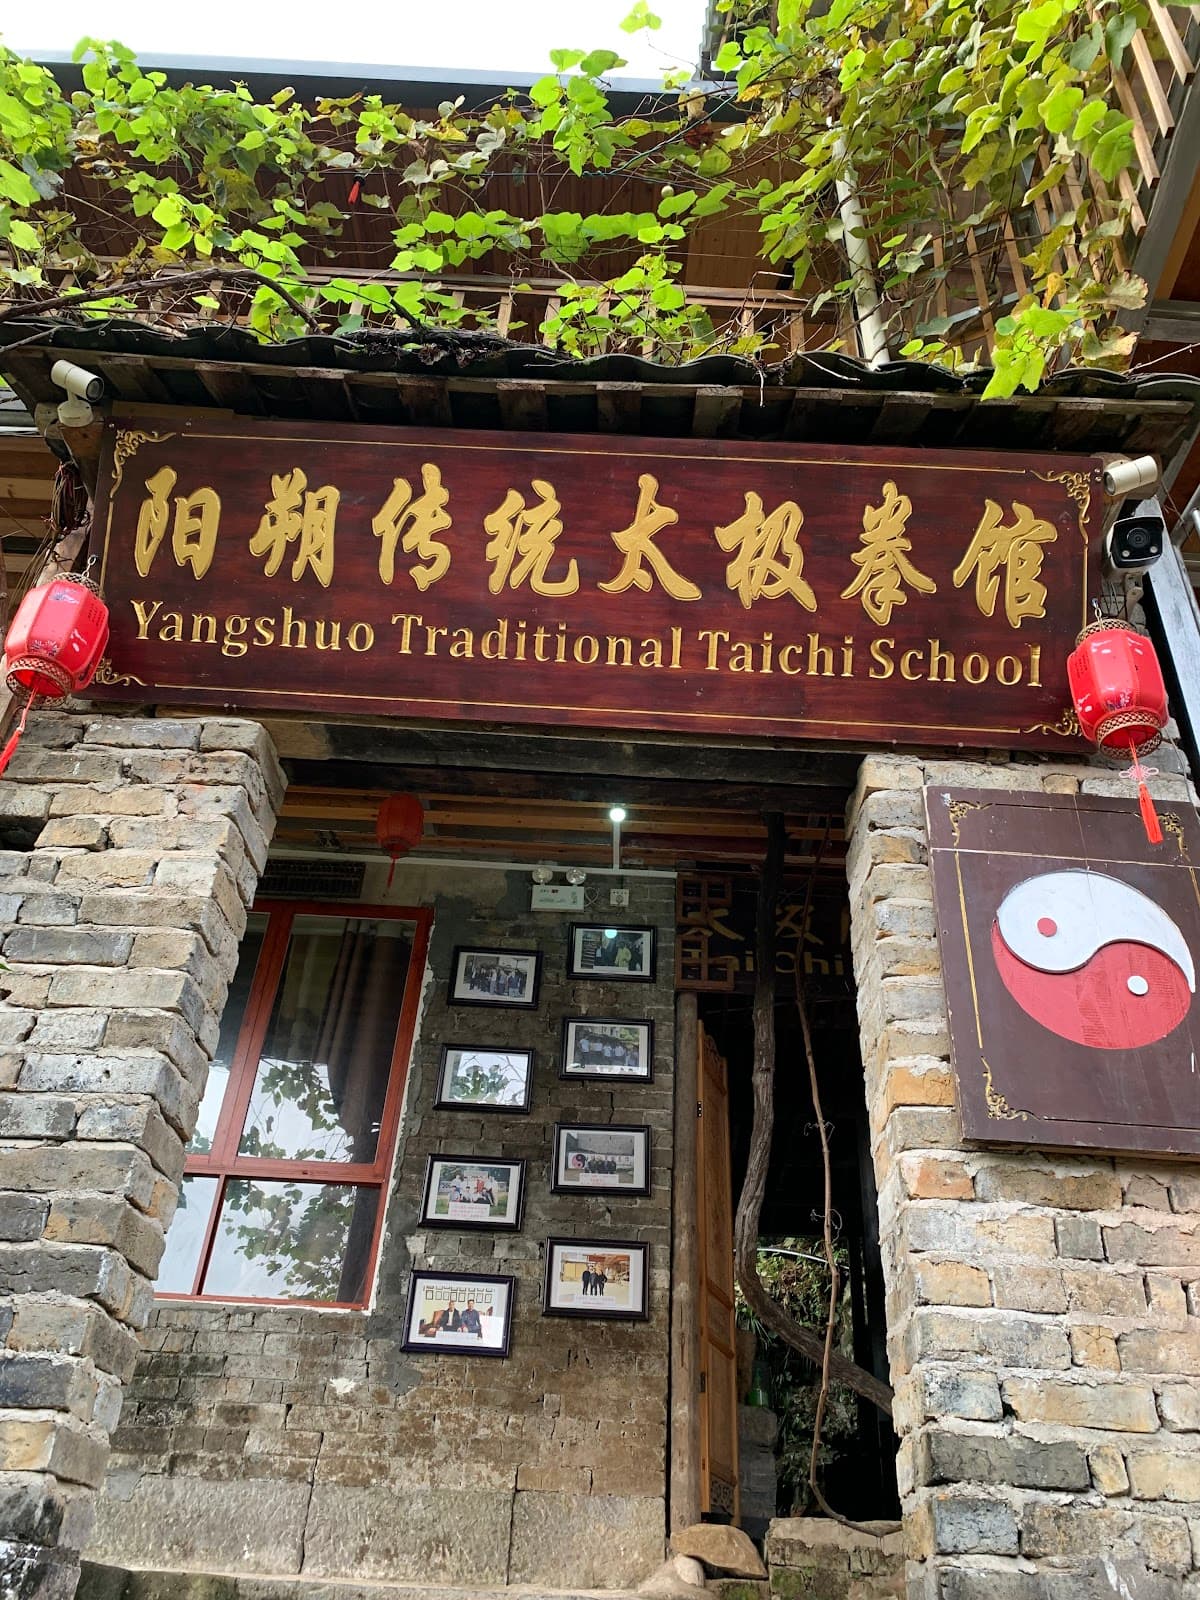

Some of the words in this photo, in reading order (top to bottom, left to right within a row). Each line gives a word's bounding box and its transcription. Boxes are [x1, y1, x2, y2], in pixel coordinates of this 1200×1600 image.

[134, 463, 1058, 628] 阳朔传统太极拳馆
[130, 600, 375, 657] Yangshuo
[391, 613, 682, 670] Traditional
[698, 629, 854, 677] Taichi
[869, 637, 1043, 687] School
